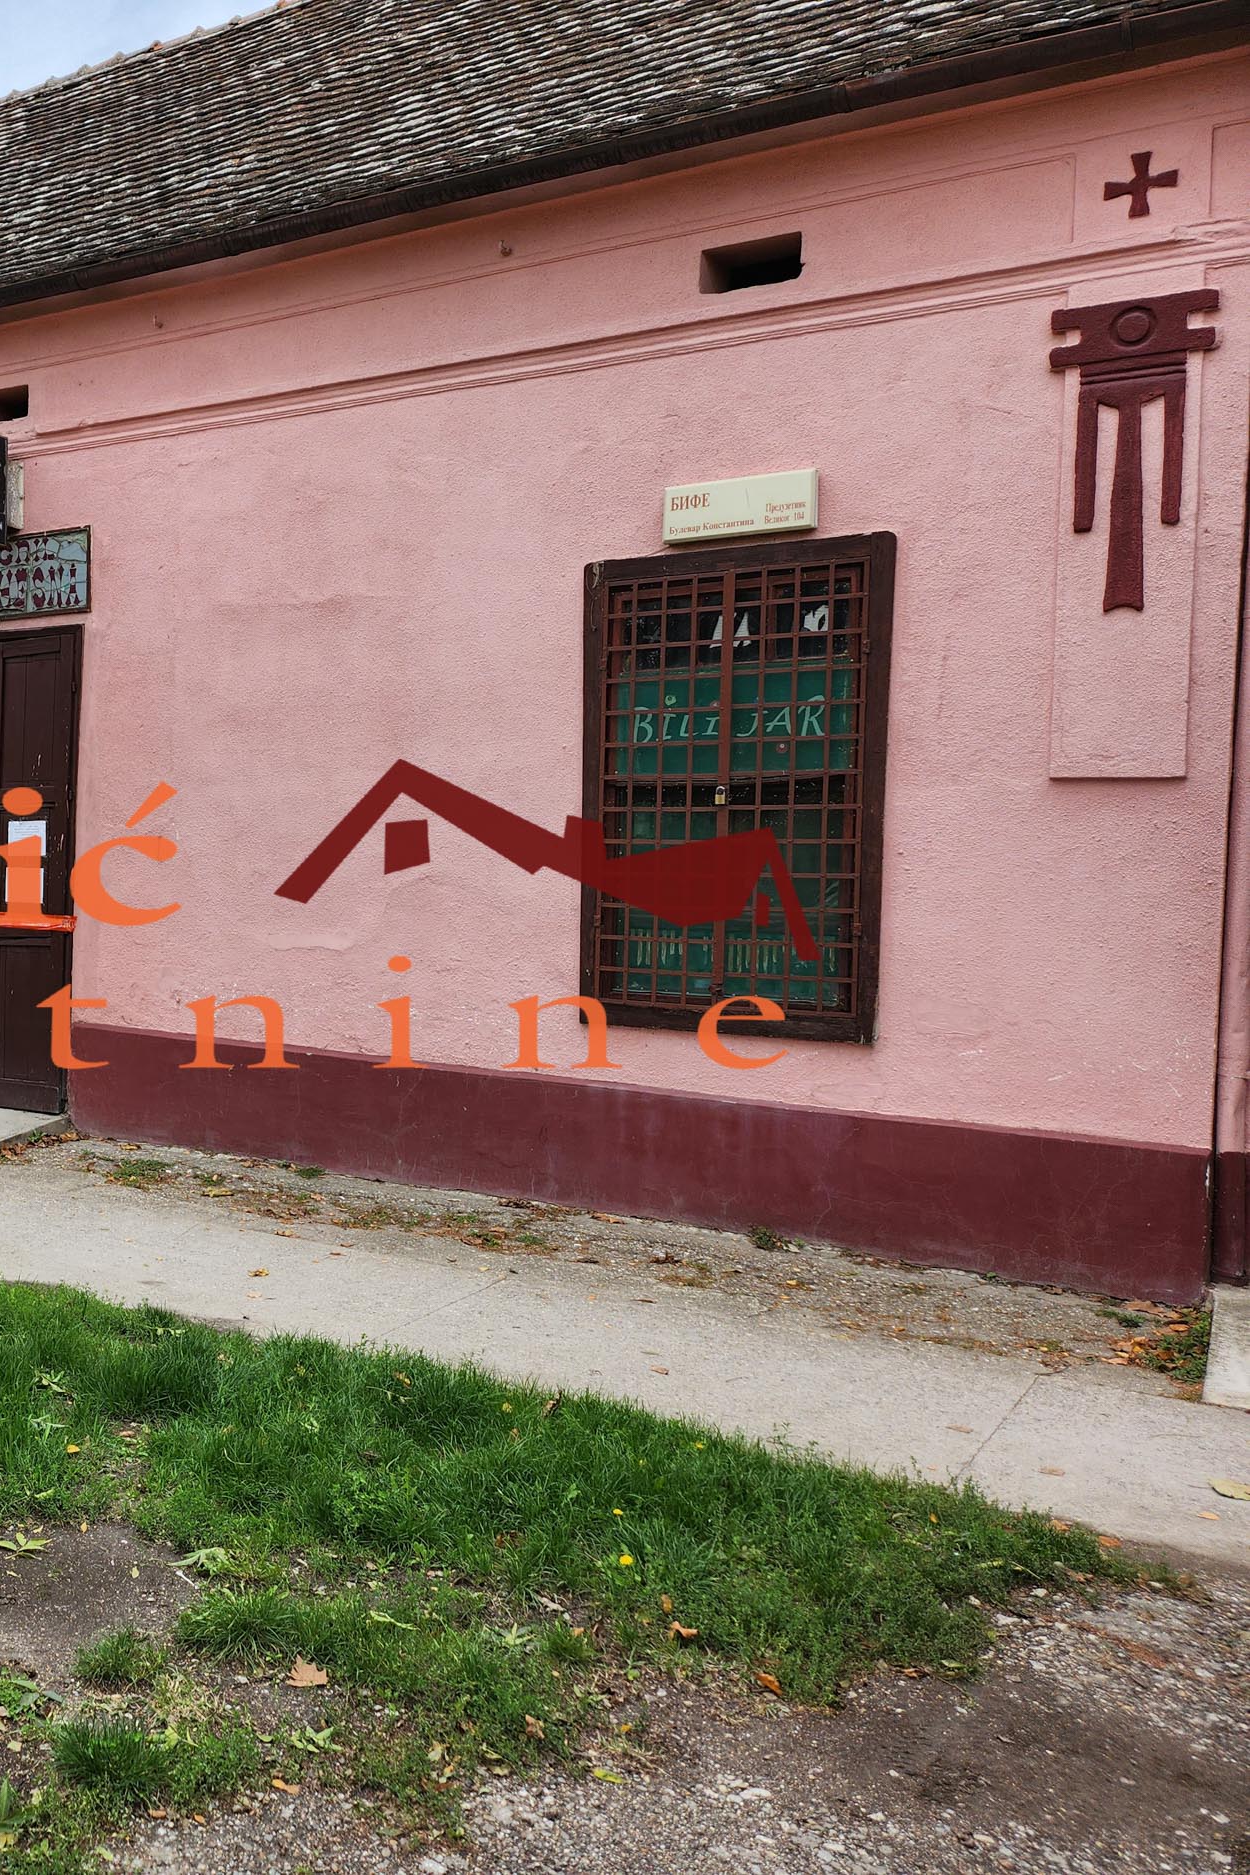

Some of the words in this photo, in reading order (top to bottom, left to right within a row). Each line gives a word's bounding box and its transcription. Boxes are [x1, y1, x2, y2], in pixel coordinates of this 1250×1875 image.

[670, 492, 711, 512] БИФЕ
[669, 525, 701, 536] Булевар
[702, 519, 755, 531] Константина
